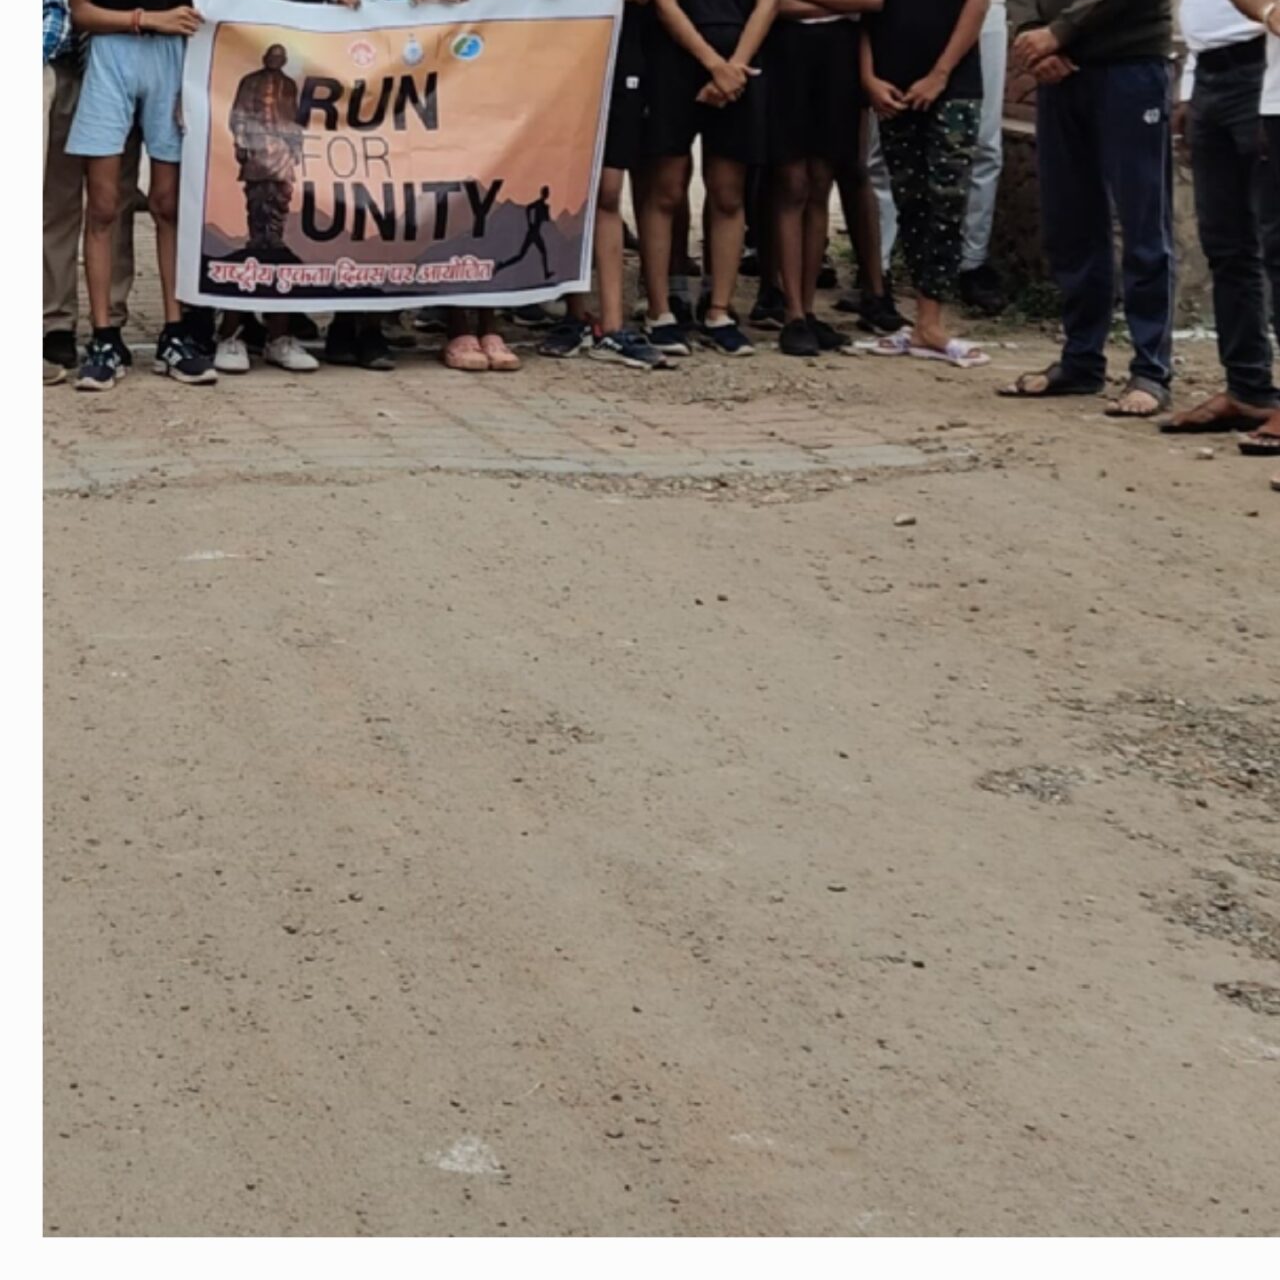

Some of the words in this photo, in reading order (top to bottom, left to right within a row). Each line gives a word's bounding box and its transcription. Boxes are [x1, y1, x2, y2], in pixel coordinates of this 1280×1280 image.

[297, 72, 438, 131] RUN
[301, 135, 392, 178] FOR
[302, 179, 504, 242] UNITY
[208, 257, 274, 291] राष्ट्रीय
[275, 263, 333, 293] एकता
[335, 257, 386, 289] दिवस
[390, 264, 416, 284] पर
